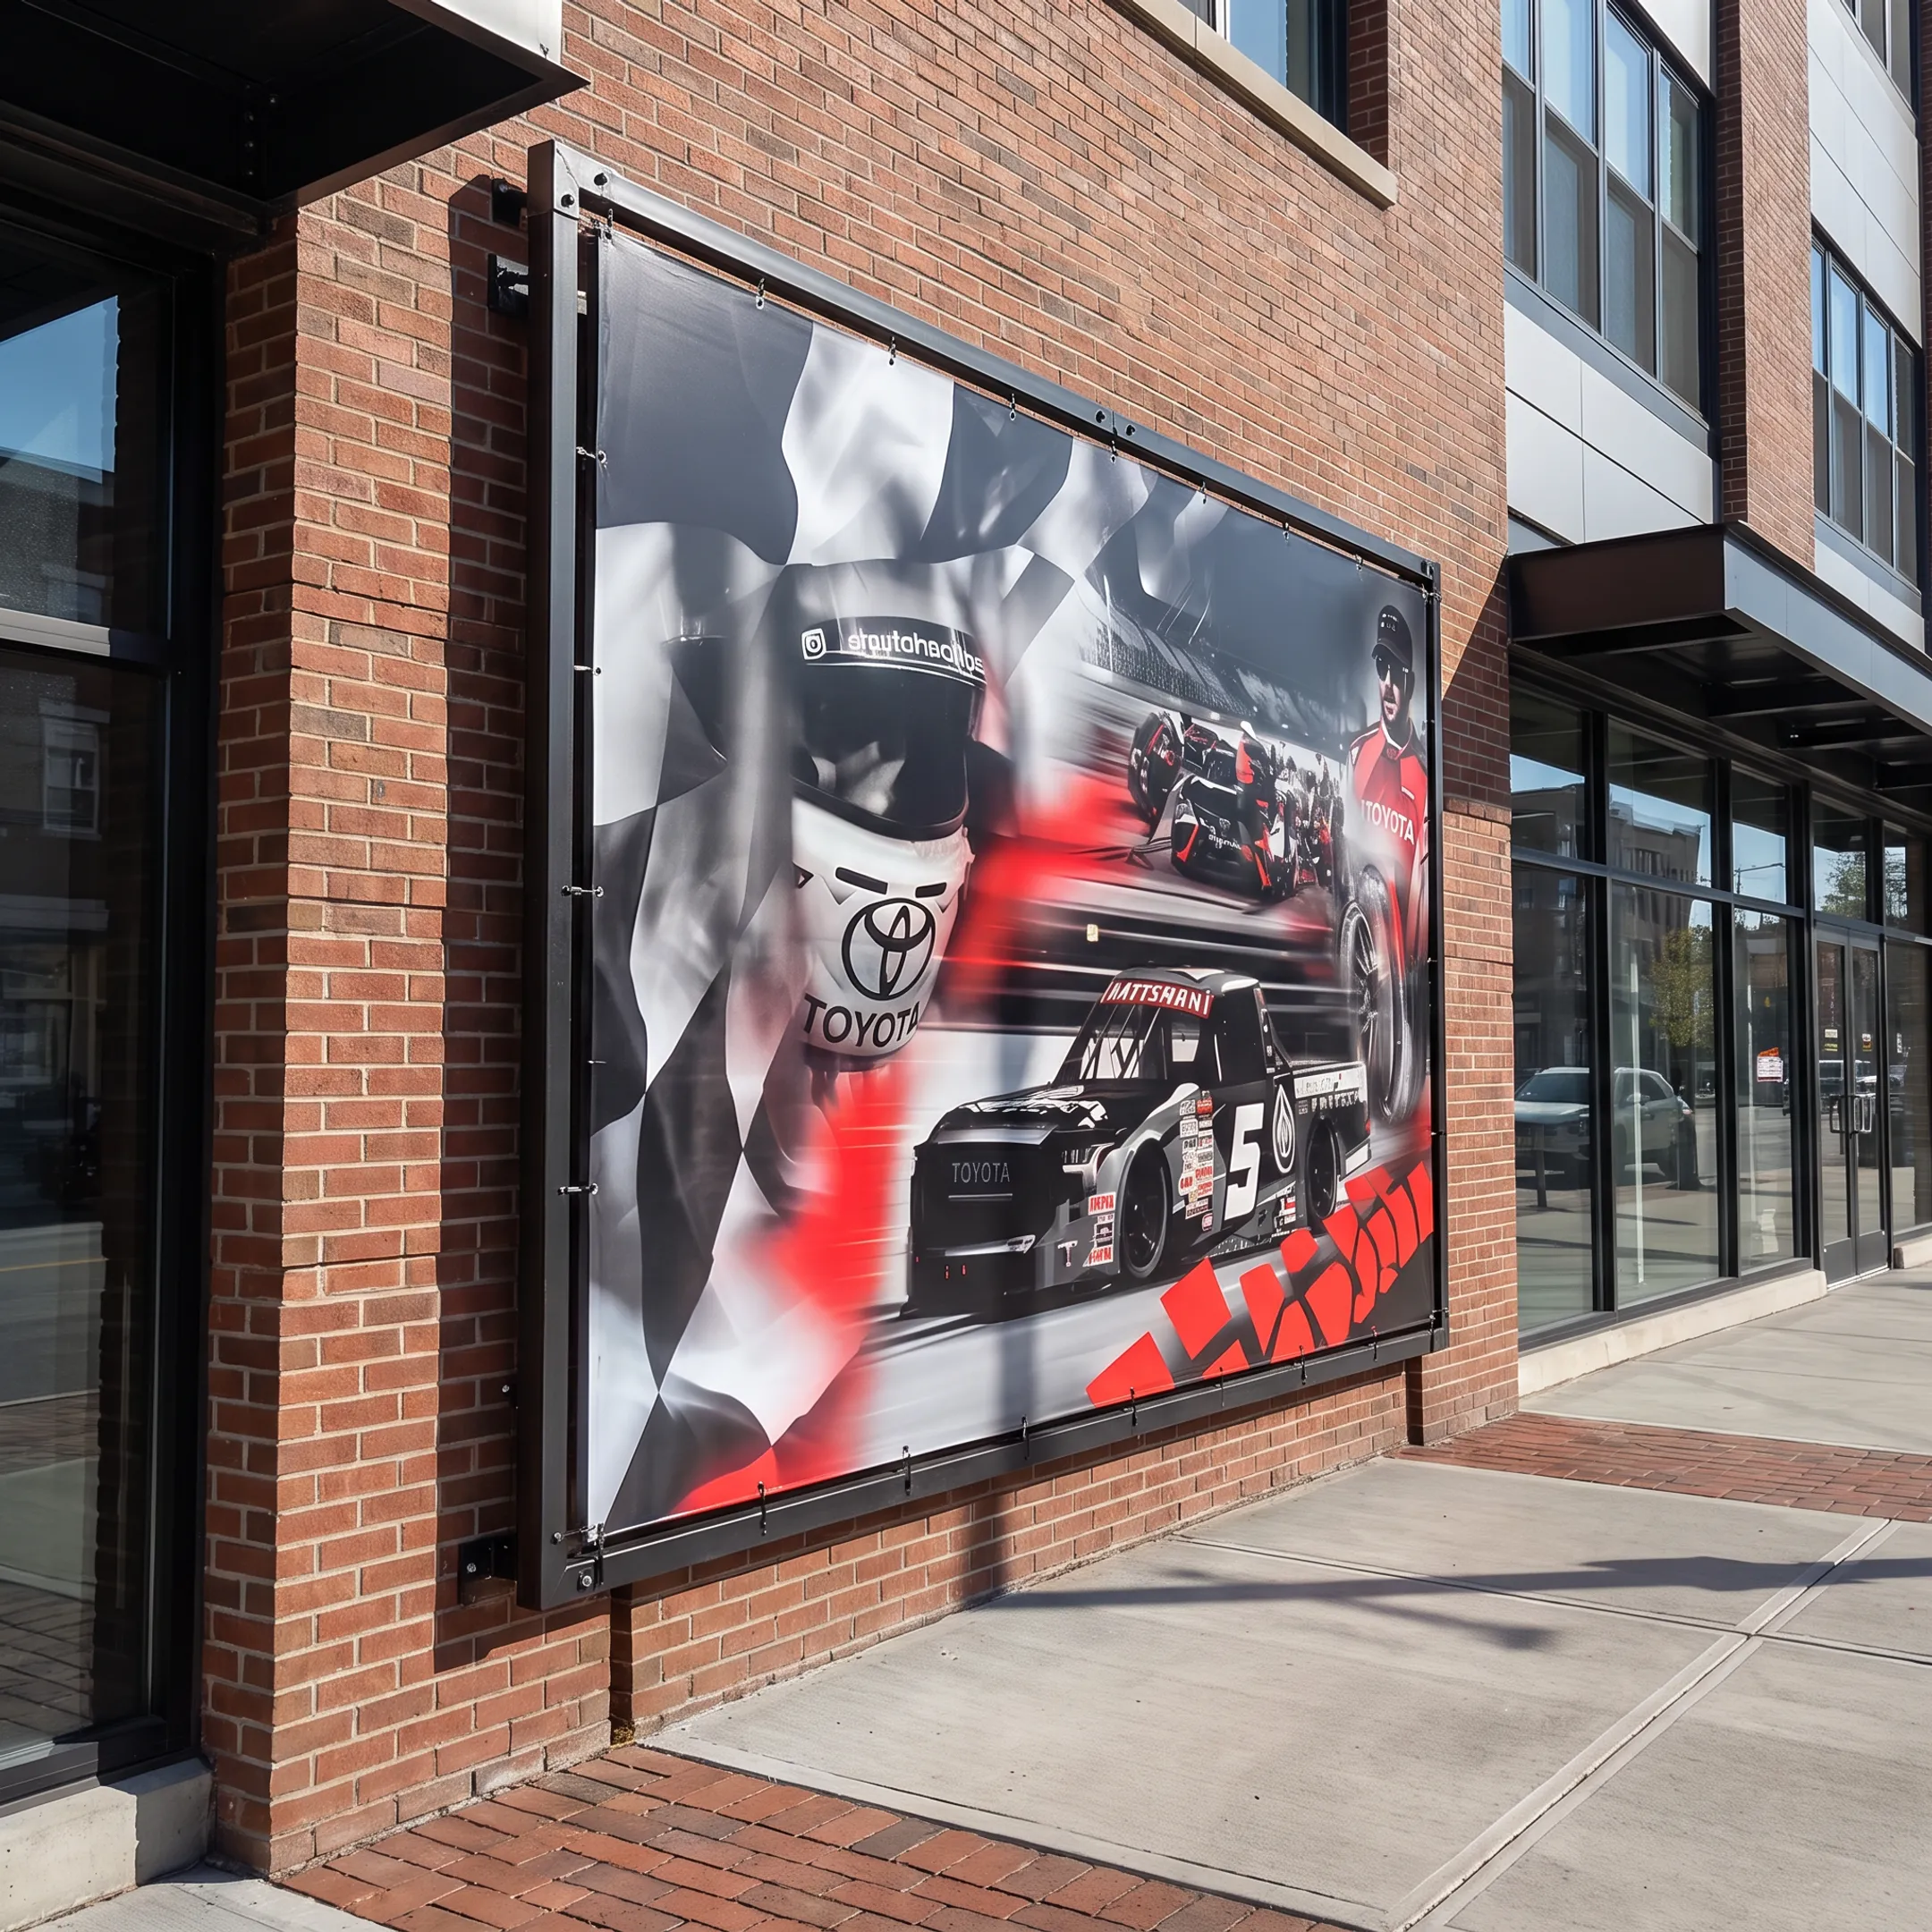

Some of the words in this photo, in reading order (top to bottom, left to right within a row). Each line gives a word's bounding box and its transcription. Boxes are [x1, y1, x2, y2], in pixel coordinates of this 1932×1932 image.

[803, 992, 920, 1047] TOYOTA
[952, 1162, 1011, 1183] TOYOTA
[1224, 1102, 1265, 1221] 5
